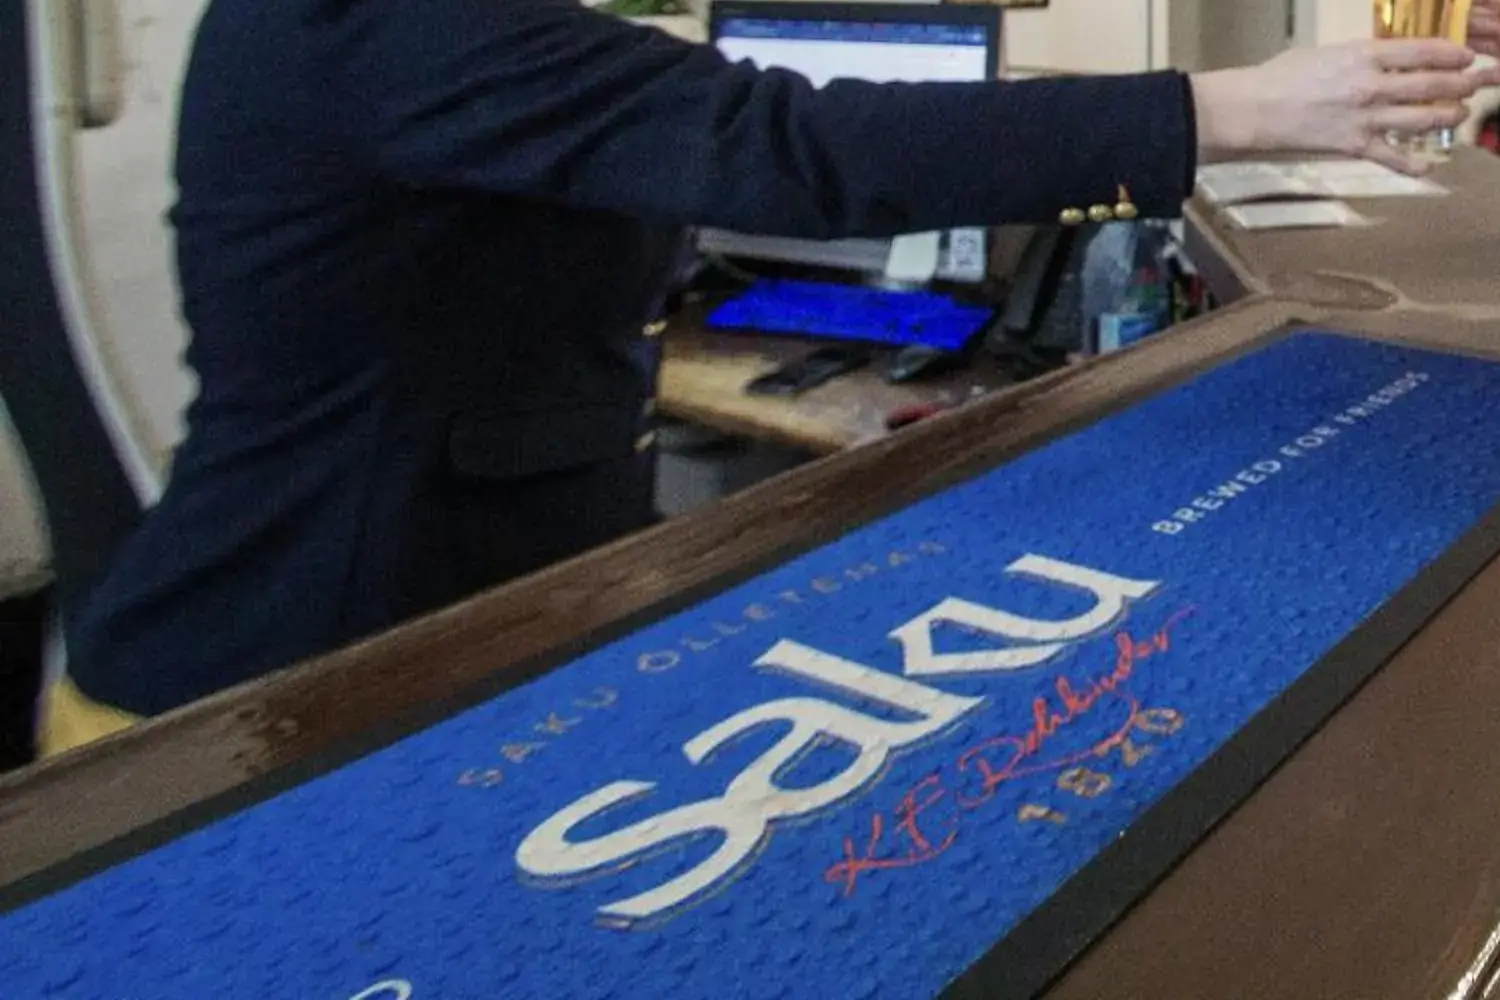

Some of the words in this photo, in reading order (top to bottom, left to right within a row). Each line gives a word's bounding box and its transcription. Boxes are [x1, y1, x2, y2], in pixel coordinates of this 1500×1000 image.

[1151, 459, 1282, 535] BREWED
[1279, 424, 1340, 458] FOR
[456, 685, 620, 789] SAKU
[514, 552, 1163, 920] saku
[1017, 706, 1187, 825] 1820
